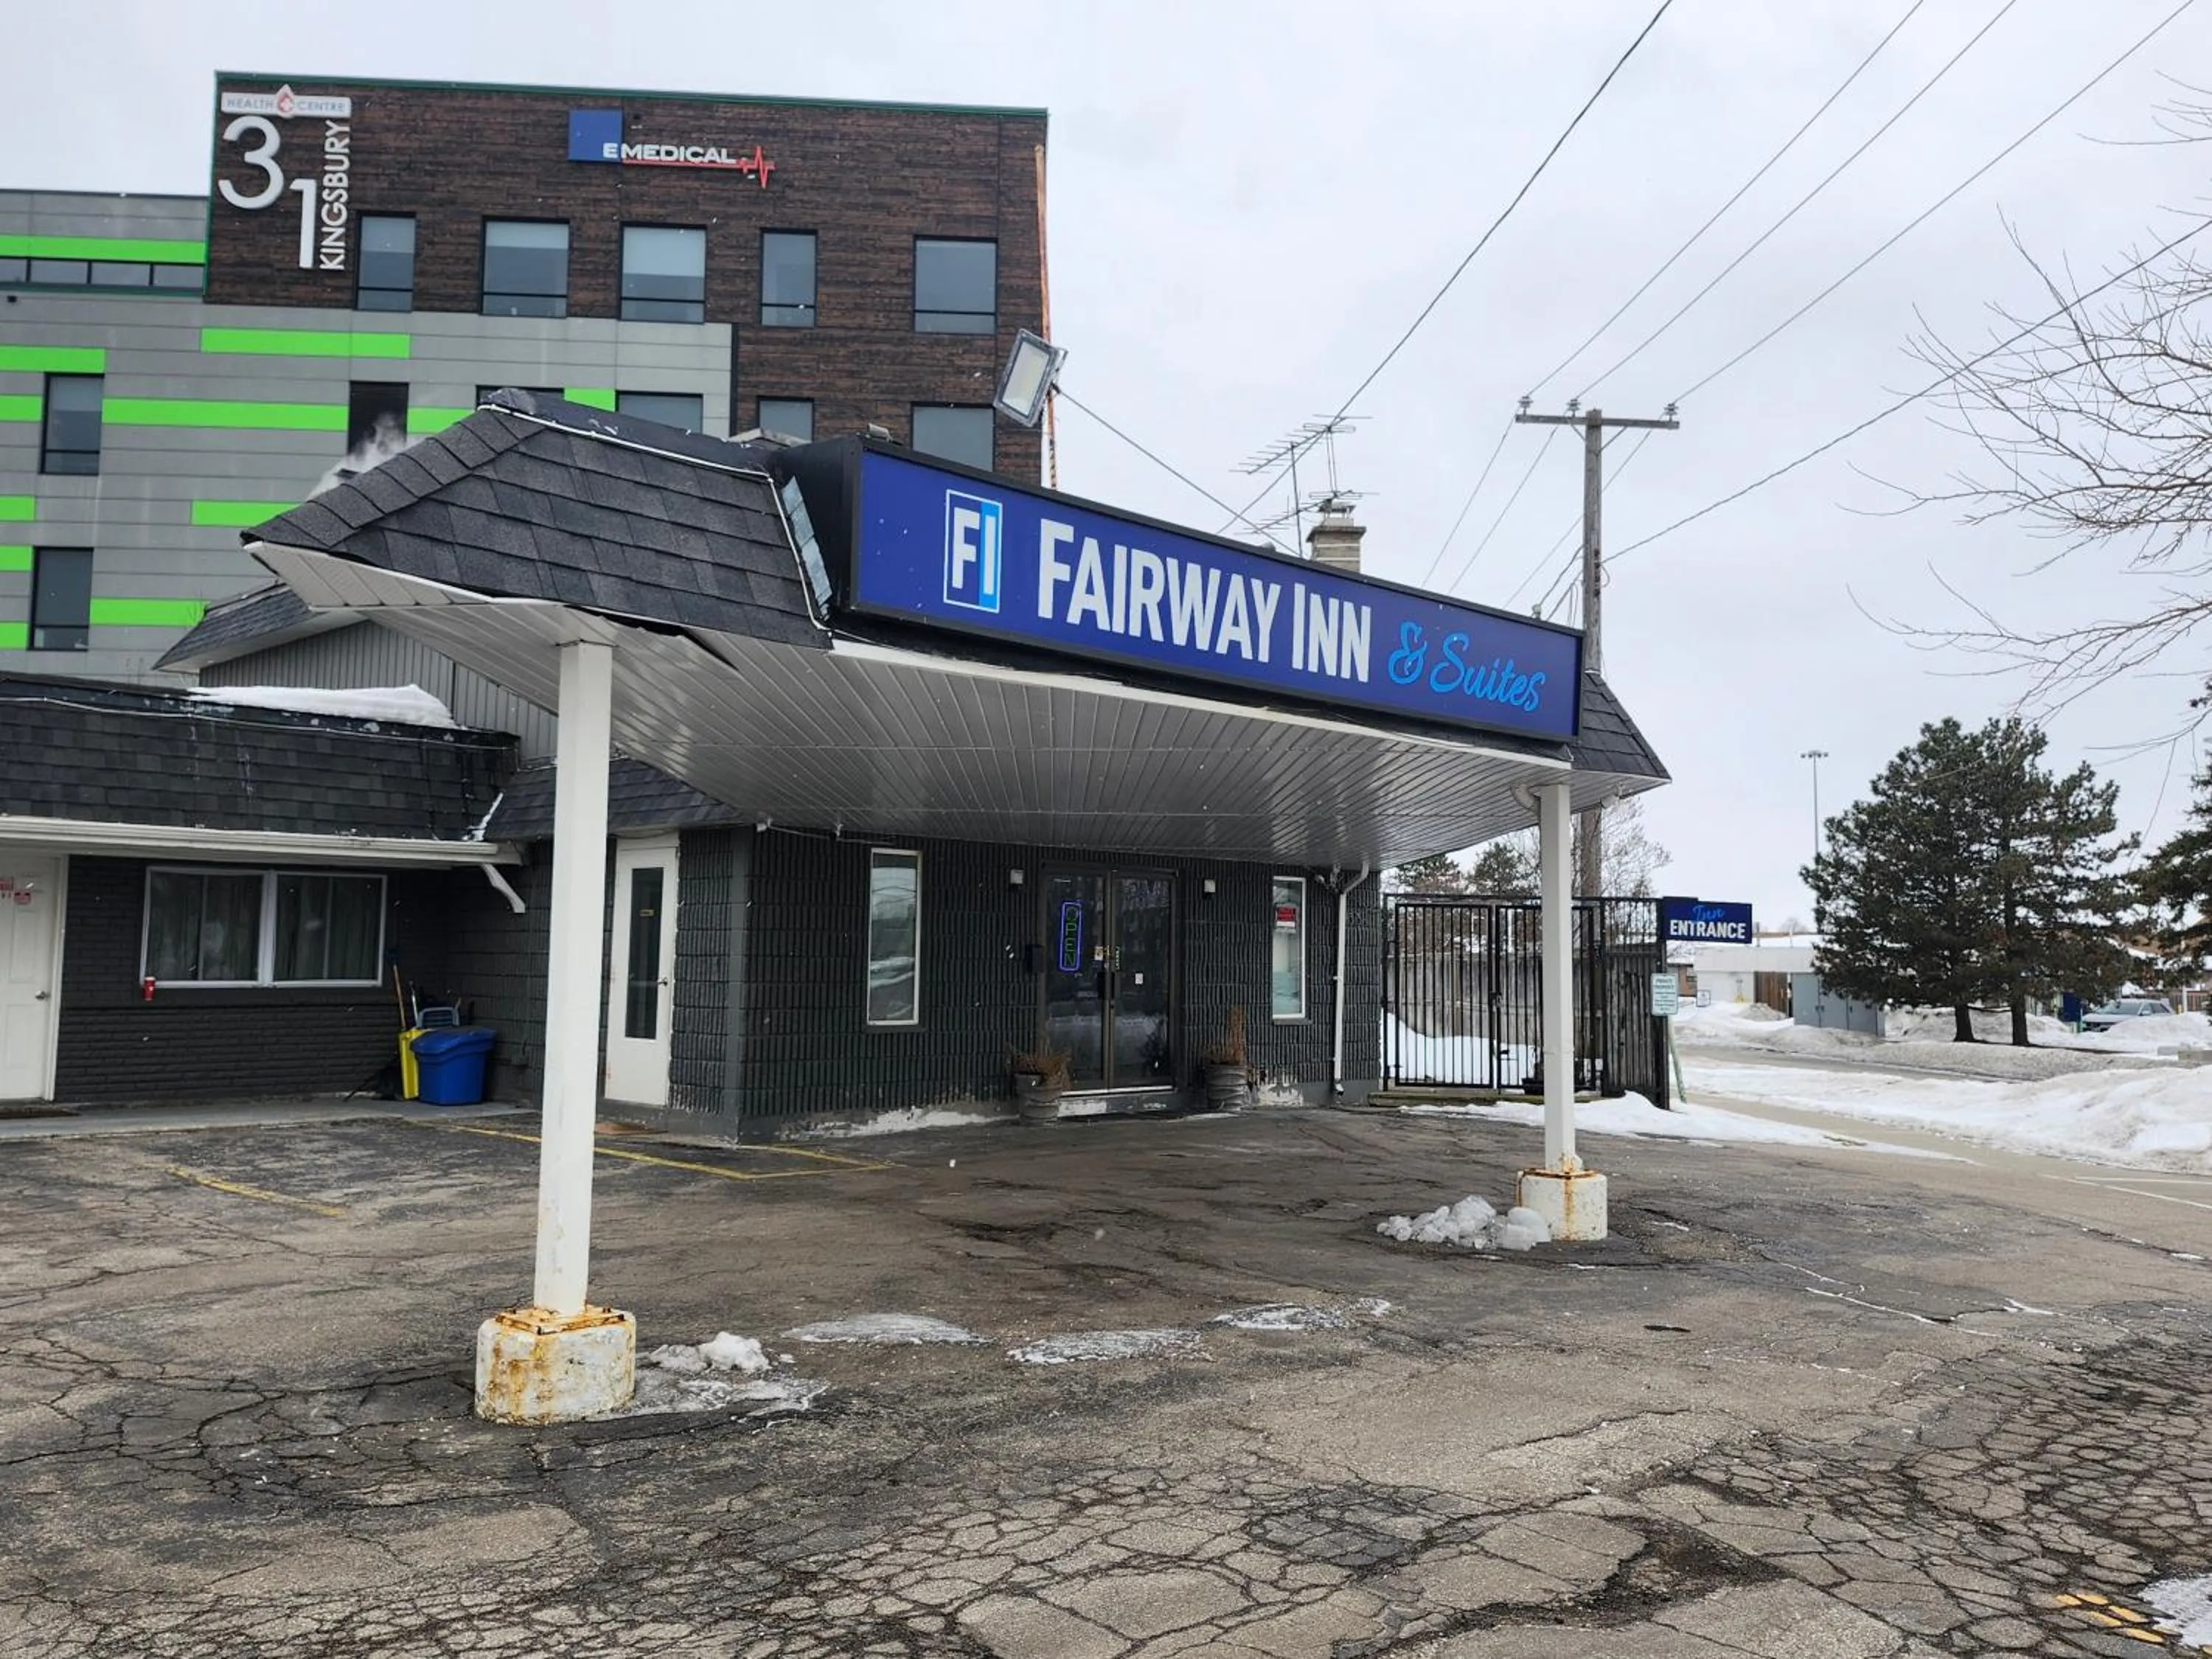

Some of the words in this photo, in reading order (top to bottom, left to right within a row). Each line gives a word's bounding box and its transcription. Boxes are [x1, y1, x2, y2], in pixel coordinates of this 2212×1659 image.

[227, 98, 274, 109] HEALTH
[297, 101, 345, 113] CENTRE
[319, 119, 351, 270] KINGSBURY
[1038, 518, 1281, 664] FAIRWAY
[1292, 582, 1371, 683] INN
[1388, 621, 1427, 684] &
[1429, 632, 1545, 712] Suites
[1064, 906, 1078, 967] OPEN
[1670, 919, 1746, 939] ENTRANCE
